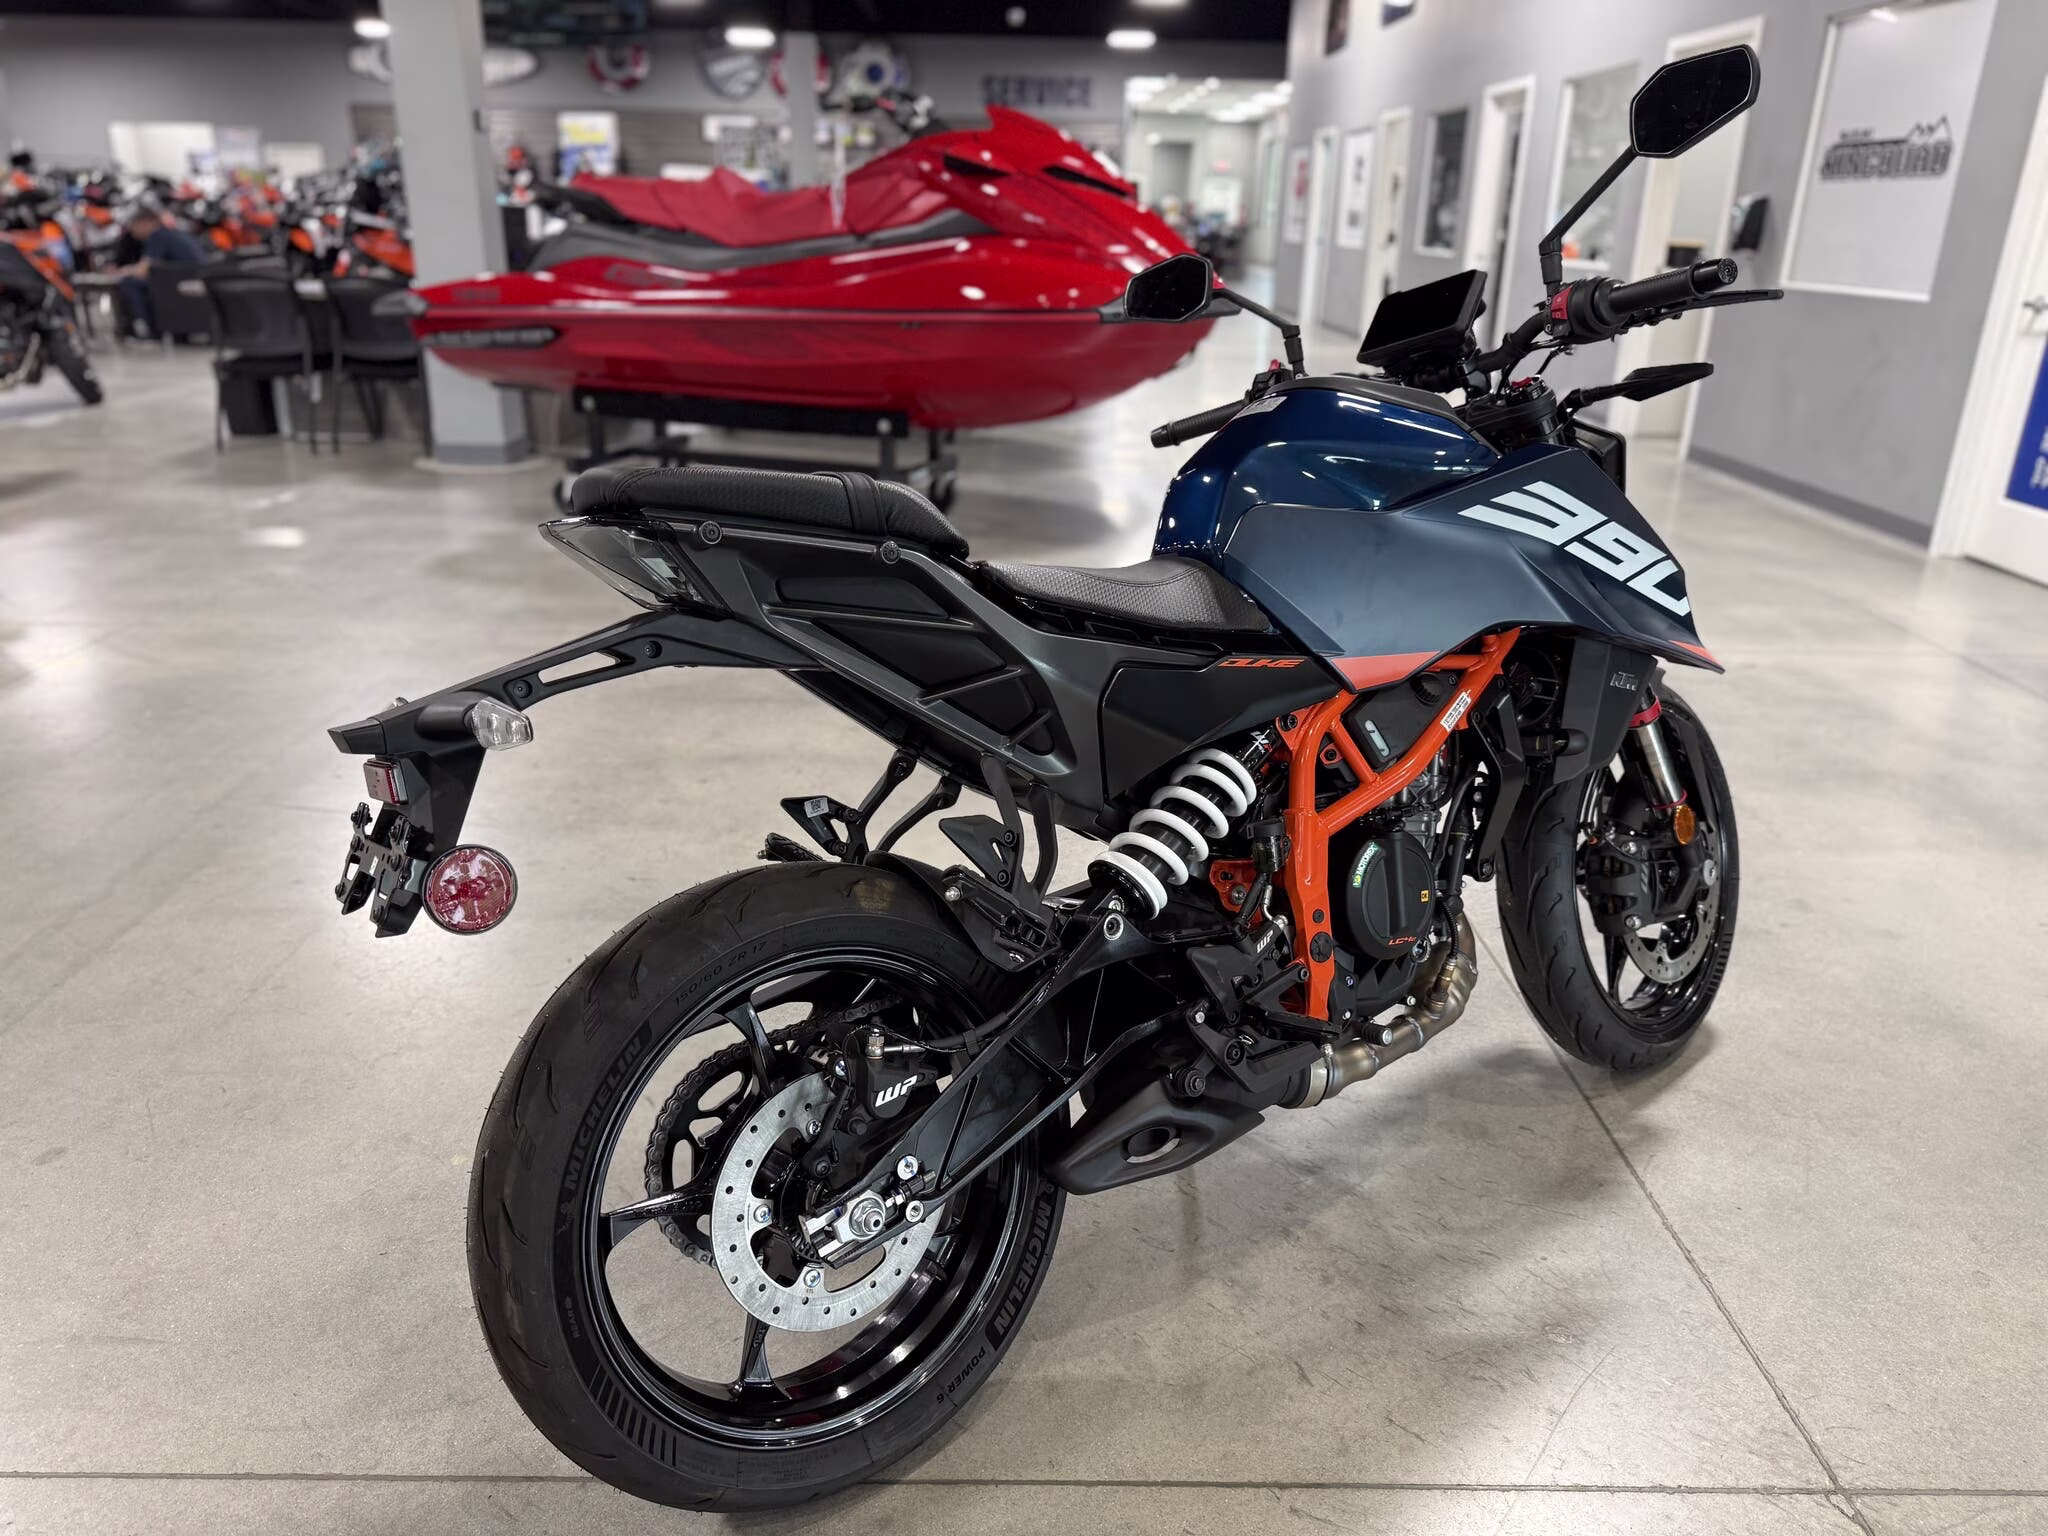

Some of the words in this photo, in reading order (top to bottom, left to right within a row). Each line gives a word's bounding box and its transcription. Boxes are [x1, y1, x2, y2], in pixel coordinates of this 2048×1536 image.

[1218, 658, 1305, 668] DUKE
[1356, 843, 1378, 876] MOTOREX
[728, 951, 747, 968] ZR
[752, 941, 769, 956] 17
[875, 1074, 918, 1108] WP
[564, 1039, 644, 1191] MICHELIN
[992, 1202, 1052, 1336] MICHELIN
[947, 1344, 987, 1395] POWER
